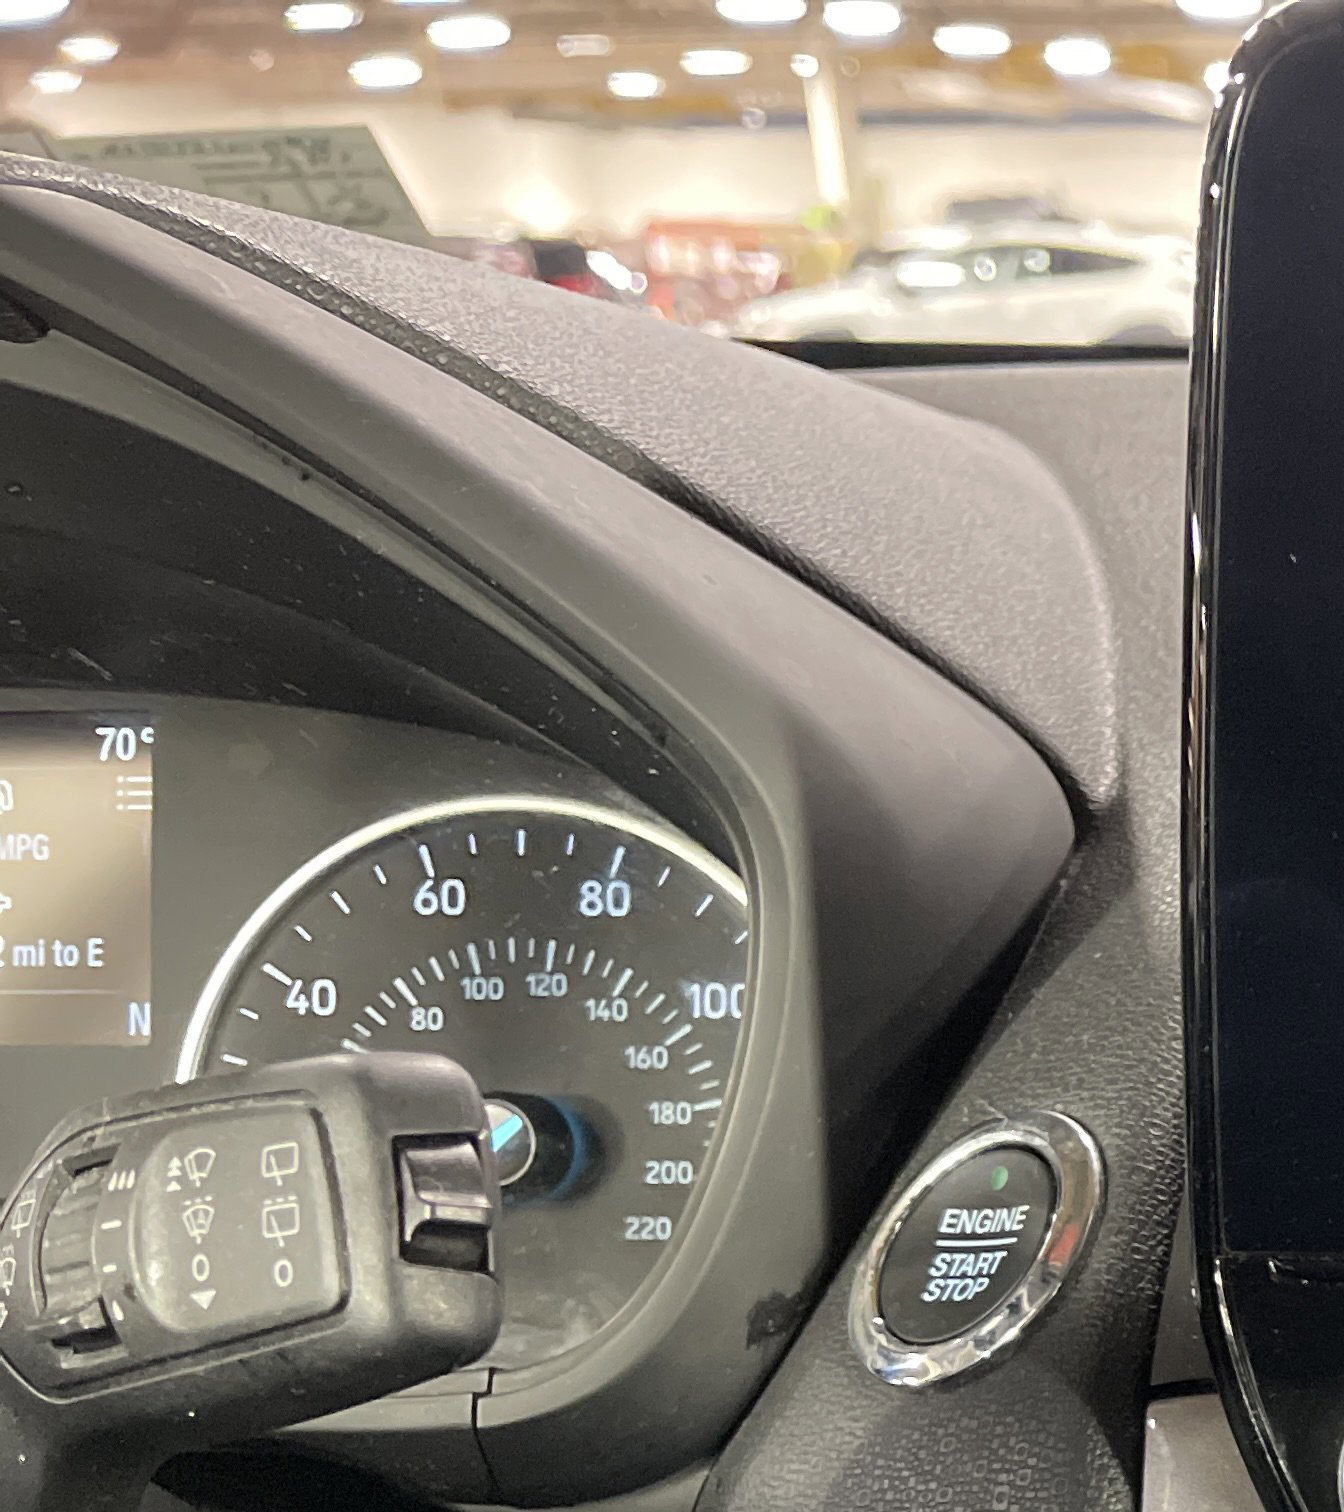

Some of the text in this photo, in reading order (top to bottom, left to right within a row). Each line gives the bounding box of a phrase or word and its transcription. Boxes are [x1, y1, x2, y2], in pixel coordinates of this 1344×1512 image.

[413, 878, 466, 916] 60
[578, 880, 632, 917] 80
[12, 938, 46, 967] mi
[52, 939, 80, 967] to
[87, 938, 105, 967] E
[286, 978, 337, 1015] 40
[461, 976, 504, 1001] 100
[525, 973, 568, 997] 120
[127, 1001, 152, 1037] N
[410, 1007, 444, 1031] 80
[585, 998, 628, 1022] 140
[624, 1045, 668, 1069] 160
[649, 1101, 692, 1125] 180
[645, 1161, 694, 1185] 200
[624, 1217, 672, 1241] 220
[937, 1205, 1030, 1235] ENGINE
[928, 1250, 1008, 1277] START
[921, 1277, 990, 1302] STOP
